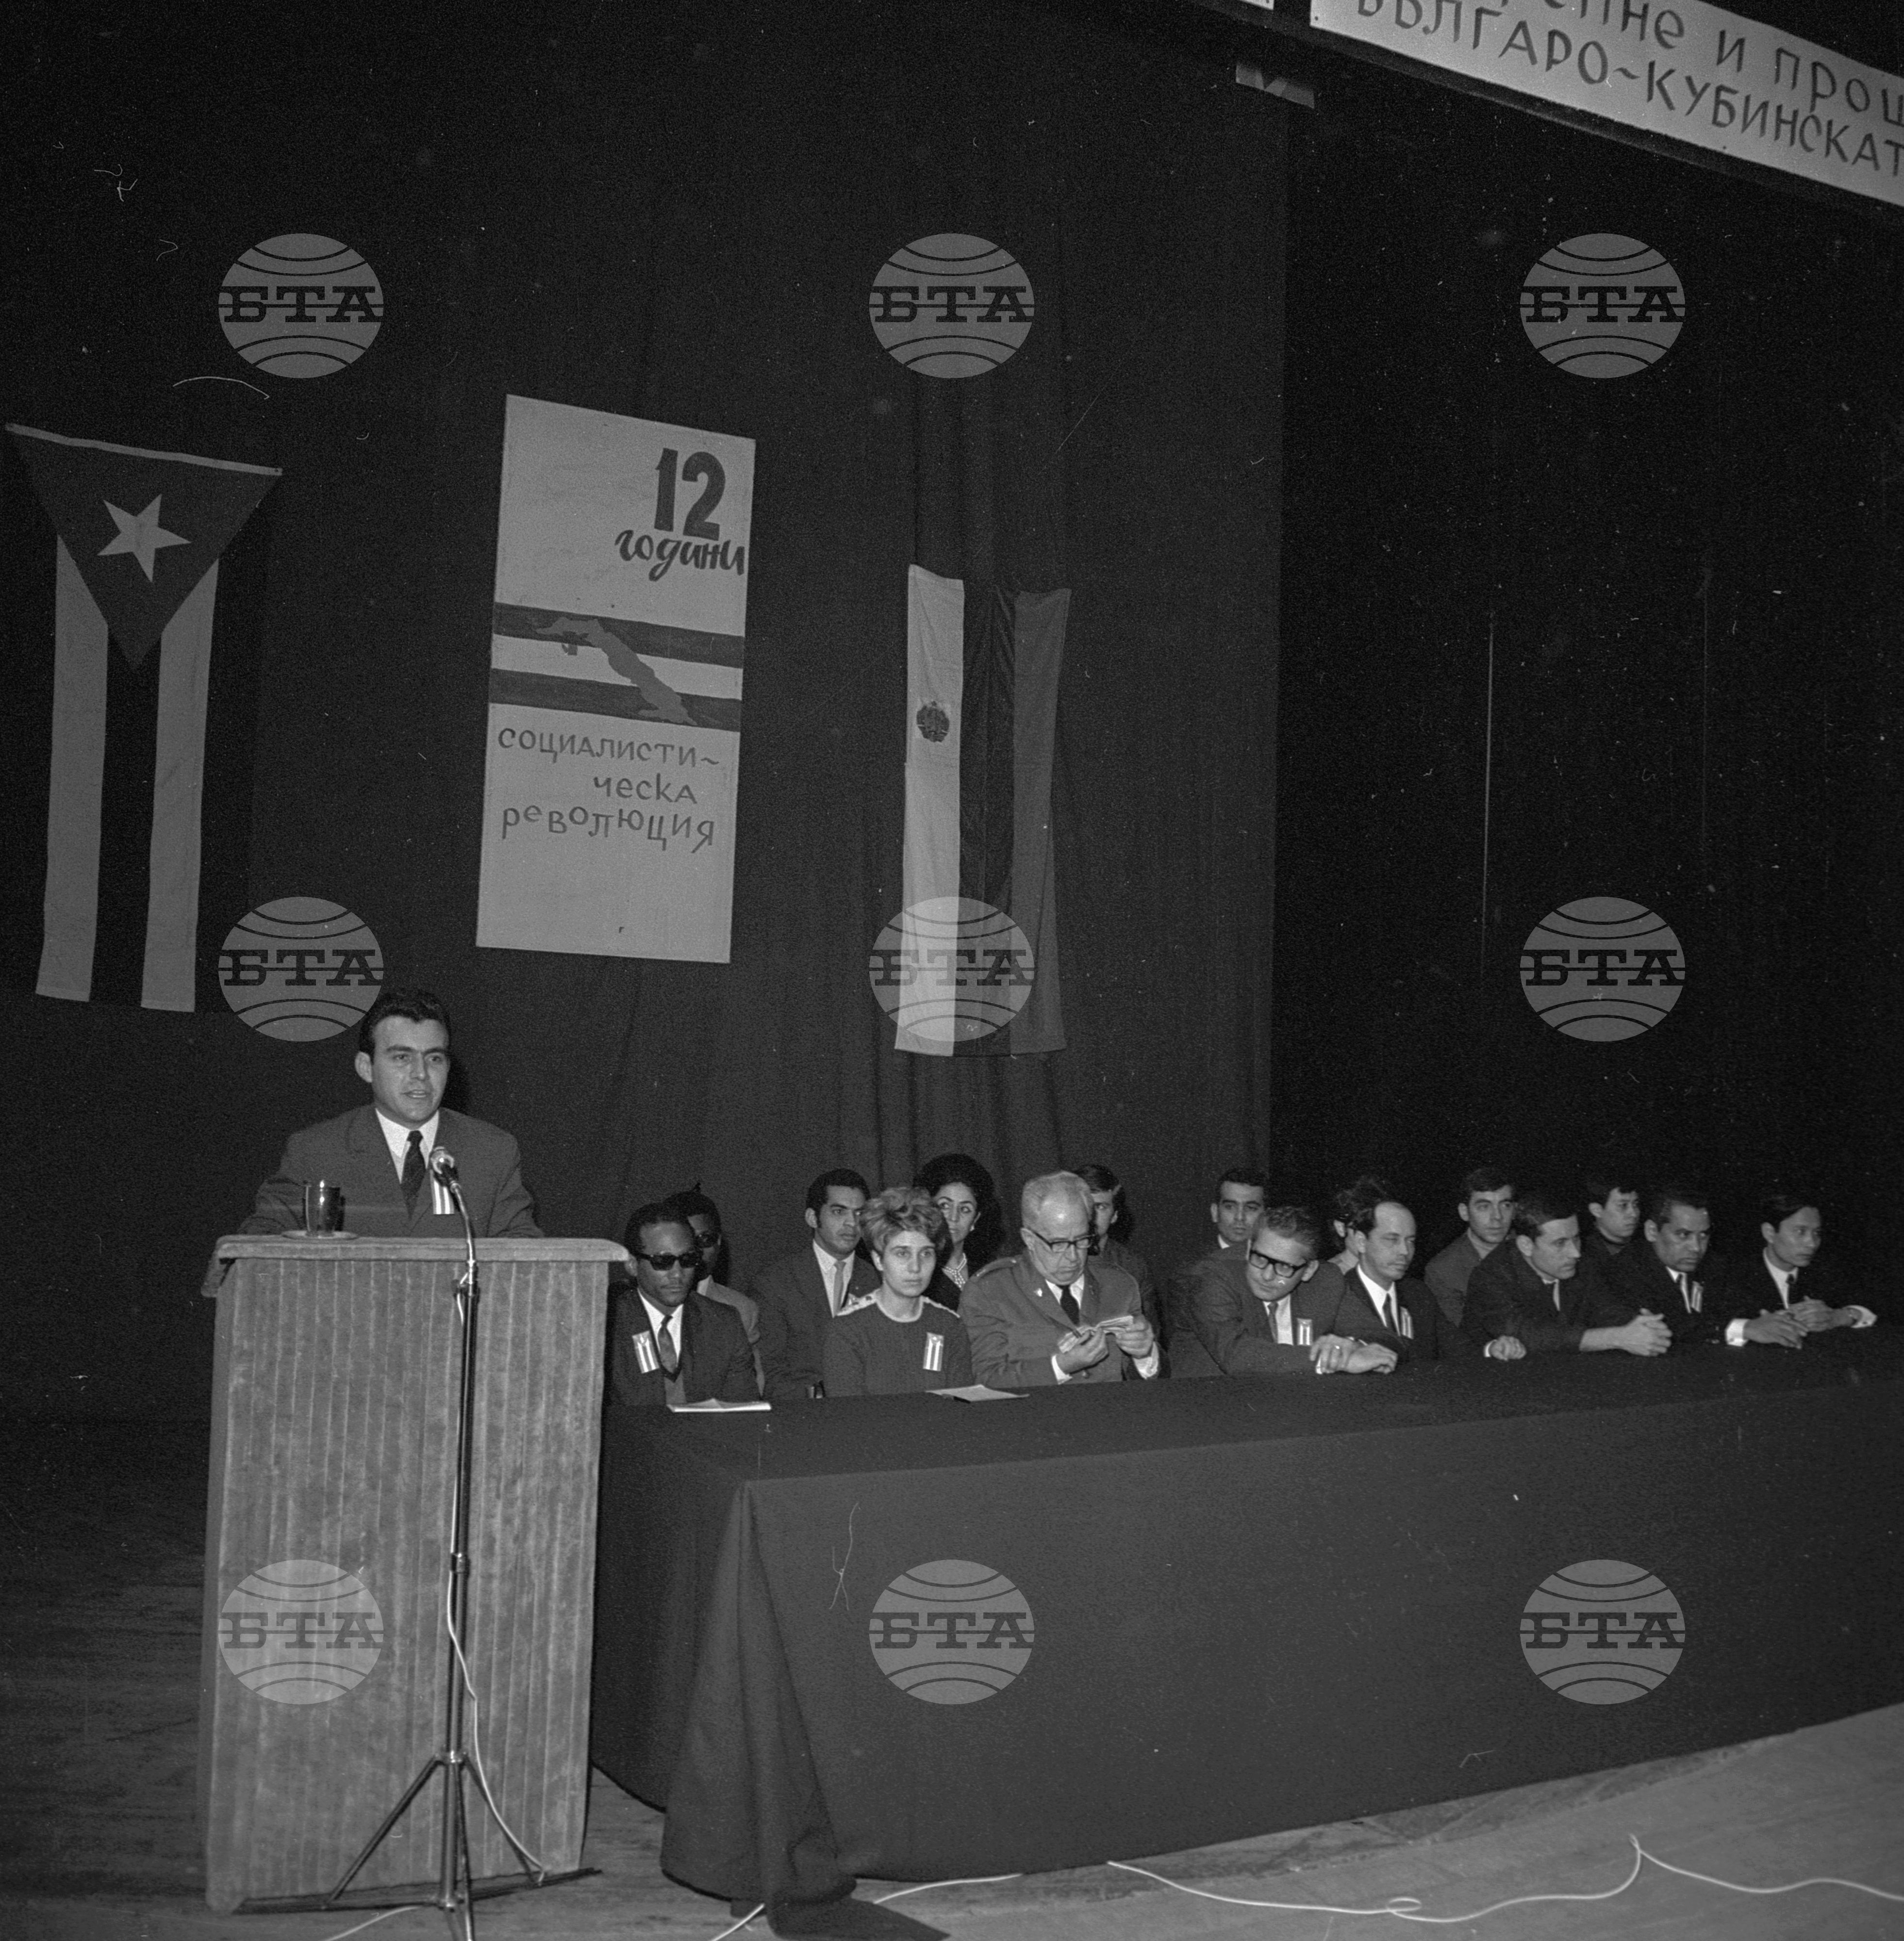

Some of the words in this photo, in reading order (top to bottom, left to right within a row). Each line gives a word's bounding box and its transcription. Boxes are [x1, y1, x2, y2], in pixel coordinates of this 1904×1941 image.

[654, 447, 726, 541] 12
[614, 529, 745, 582] години
[502, 805, 715, 854] революция
